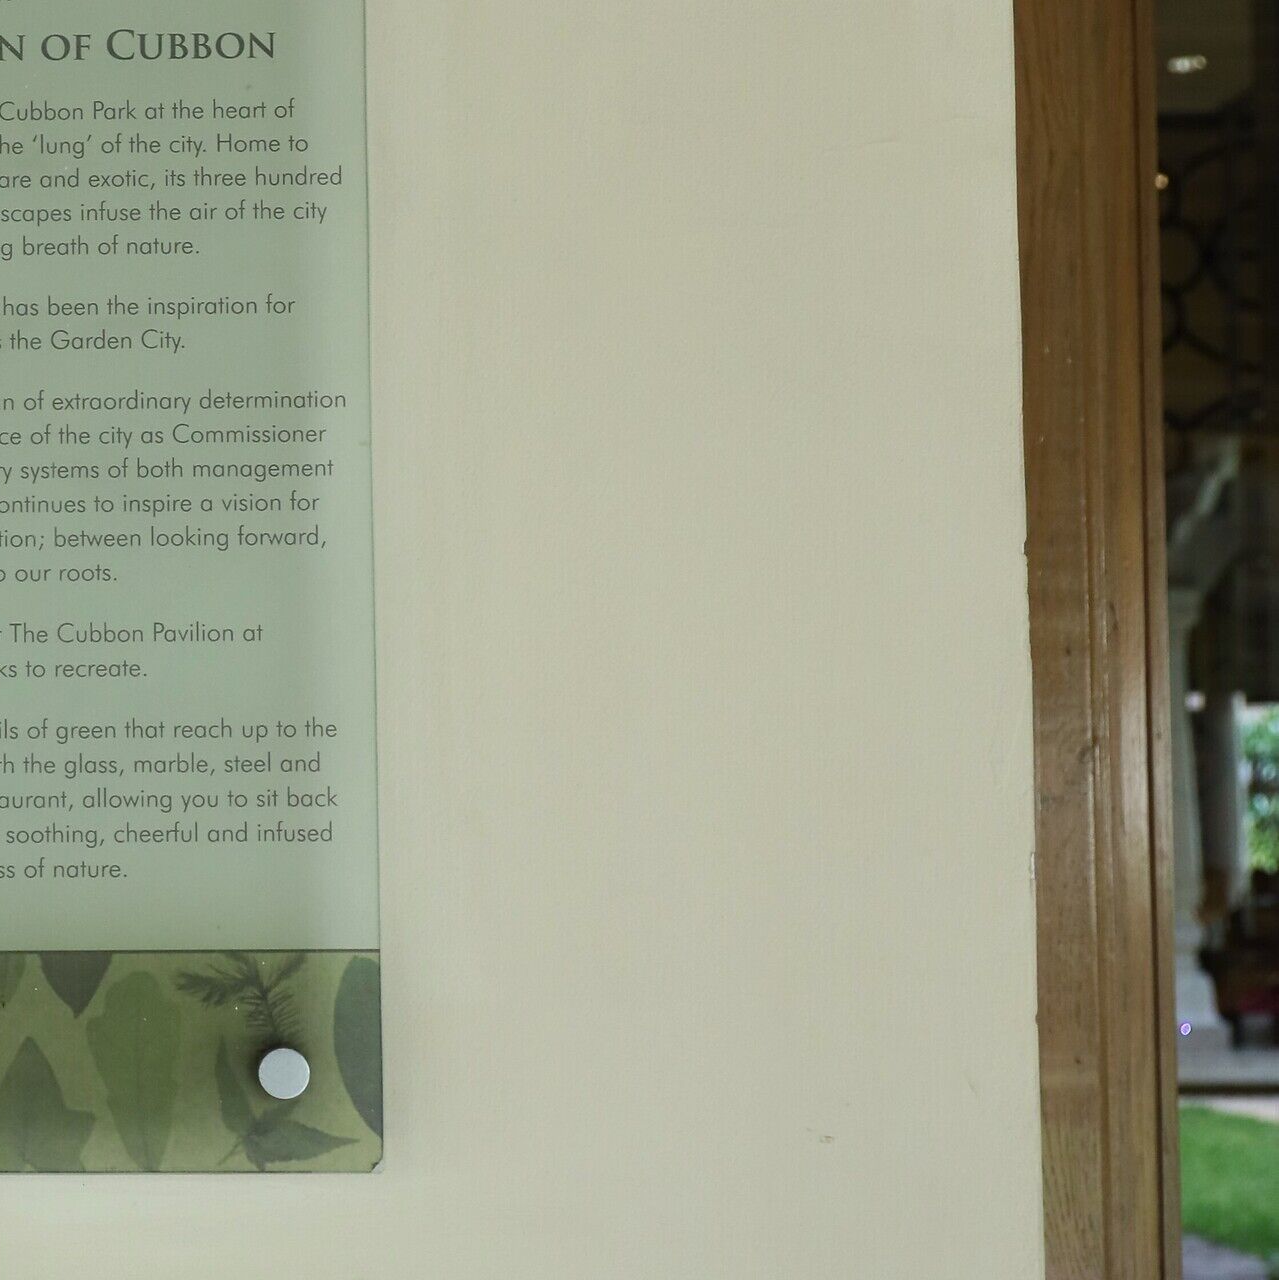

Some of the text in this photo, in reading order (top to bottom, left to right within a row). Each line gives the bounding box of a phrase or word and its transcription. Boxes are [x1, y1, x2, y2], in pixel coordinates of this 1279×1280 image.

[40, 34, 91, 62] OF
[106, 28, 276, 61] CUBBON
[93, 99, 137, 121] Park
[144, 102, 165, 120] at
[171, 98, 204, 120] the
[212, 97, 267, 119] heart
[274, 97, 295, 119] of
[39, 167, 80, 189] and
[88, 169, 156, 192] exotic,
[165, 168, 186, 187] its
[193, 165, 247, 187] three
[255, 165, 342, 187] hundred
[22, 234, 89, 257] breath
[97, 234, 119, 256] of
[126, 237, 200, 255] nature.
[3, 294, 39, 316] has
[47, 294, 99, 316] been
[106, 294, 140, 316] the
[147, 296, 258, 320] inspiration
[265, 292, 296, 314] for
[9, 328, 42, 350] the
[50, 328, 132, 350] Garden
[141, 328, 185, 355] City.
[23, 389, 45, 411] of
[51, 389, 192, 416] extraordinary
[199, 387, 346, 409] determination
[30, 423, 52, 446] of
[58, 422, 91, 445] the
[98, 425, 133, 450] city
[140, 430, 164, 444] as
[172, 423, 327, 444] Commissioner
[93, 496, 115, 514] to
[123, 493, 192, 518] inspire
[200, 498, 213, 512] a
[221, 493, 282, 512] vision
[289, 489, 320, 512] for
[14, 568, 52, 583] our
[59, 564, 117, 583] roots.
[8, 621, 49, 644] The
[56, 621, 144, 644] Cubbon
[153, 620, 234, 642] Pavilion
[242, 624, 263, 642] at
[25, 660, 46, 678] to
[55, 660, 147, 678] recreate.
[26, 718, 49, 740] of
[55, 725, 117, 745] green
[124, 717, 166, 739] that
[173, 717, 233, 739] reach
[242, 724, 269, 744] up
[275, 720, 297, 739] to
[304, 716, 338, 739] the
[22, 752, 56, 775] the
[64, 752, 124, 780] glass,
[134, 751, 215, 776] marble,
[224, 751, 271, 773] steel
[280, 750, 321, 773] and
[23, 856, 45, 879] of
[53, 860, 128, 879] nature.
